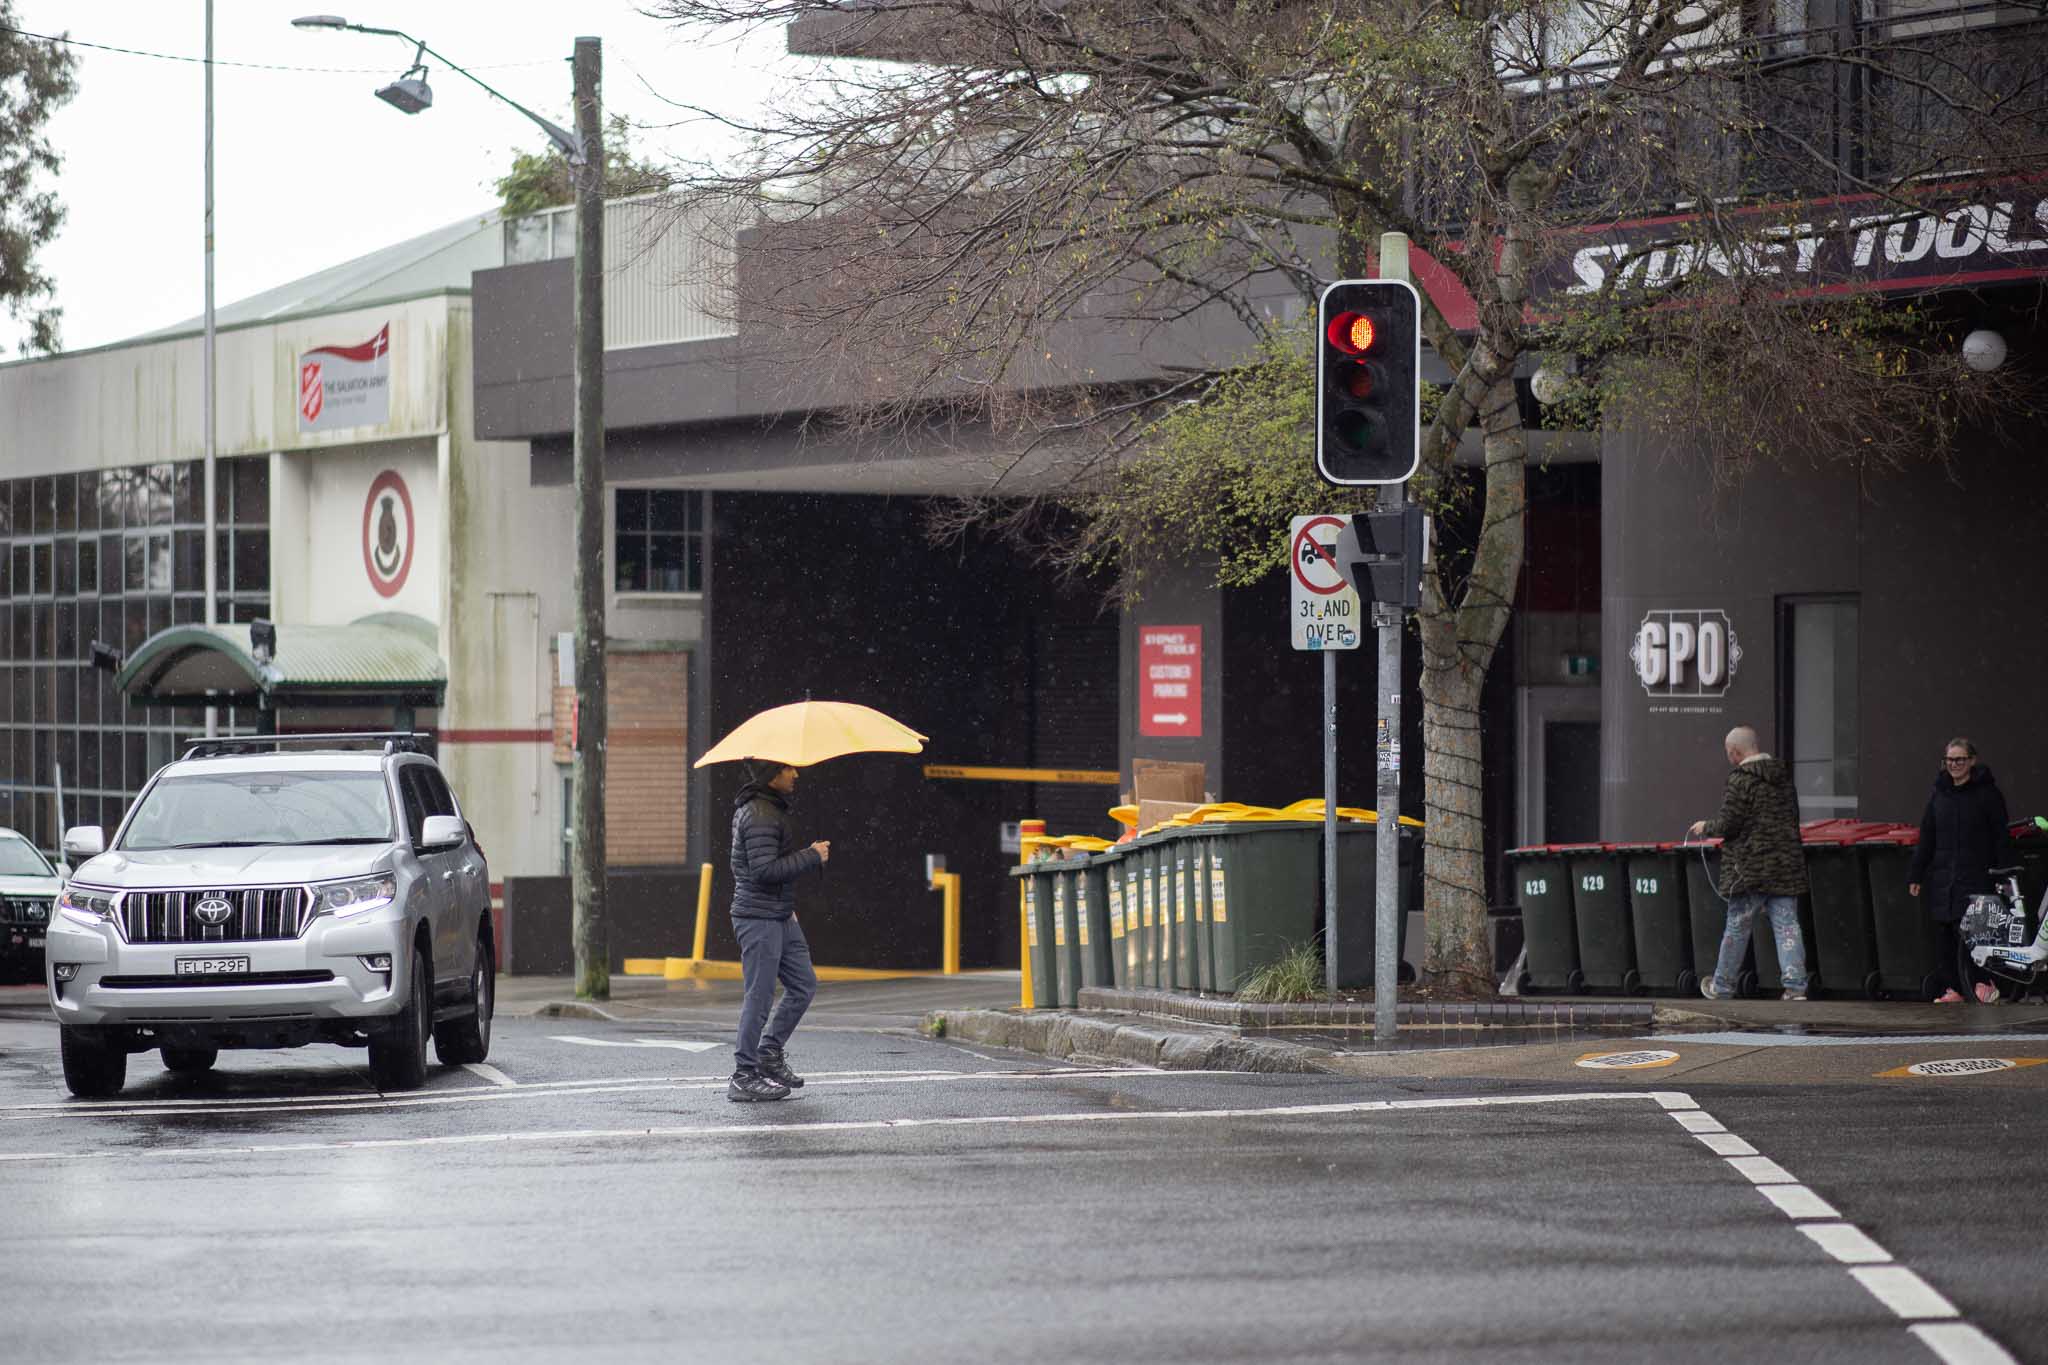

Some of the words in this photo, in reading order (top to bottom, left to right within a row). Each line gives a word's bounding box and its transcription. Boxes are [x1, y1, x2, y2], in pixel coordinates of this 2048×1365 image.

[1566, 219, 1839, 295] SYDNEY
[1300, 600, 1315, 617] 3t
[1323, 599, 1350, 617] AND
[1306, 623, 1346, 641] OVER
[1641, 621, 1724, 686] GPO
[1526, 879, 1547, 896] 429
[1582, 875, 1604, 891] 429
[1635, 878, 1657, 894] 429
